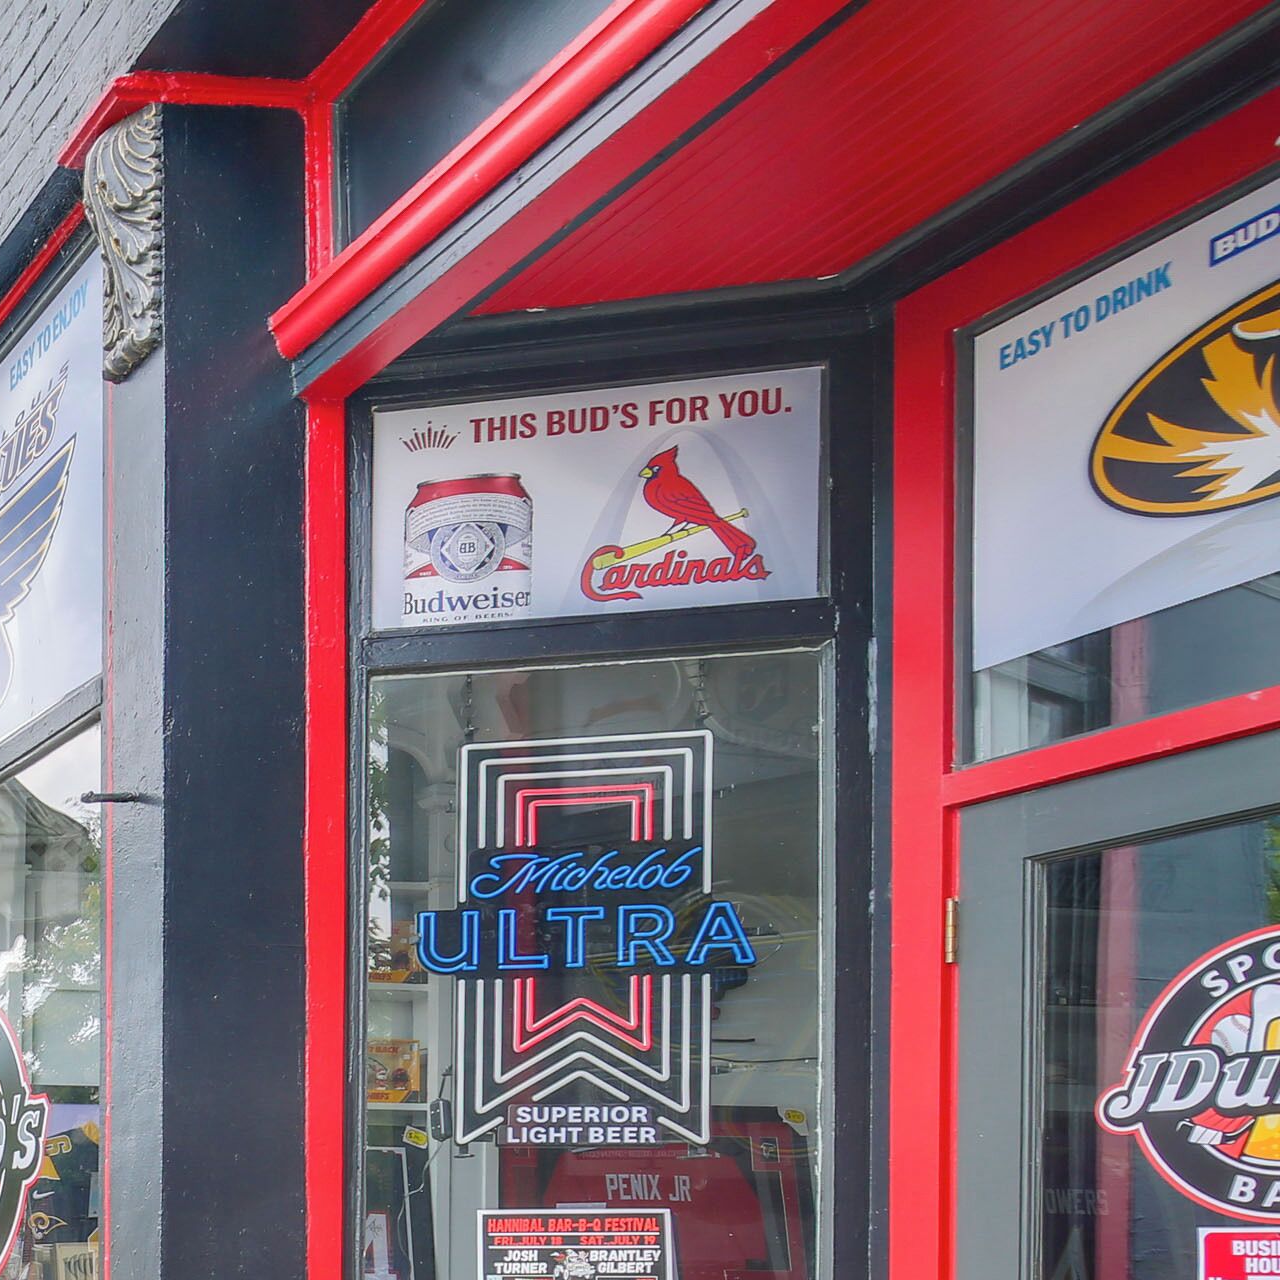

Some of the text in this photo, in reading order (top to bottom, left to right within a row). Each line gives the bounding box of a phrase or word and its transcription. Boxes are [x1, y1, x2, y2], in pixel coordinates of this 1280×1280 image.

[1213, 212, 1280, 261] BUD
[1000, 261, 1173, 370] EASY TO DRINK
[10, 281, 90, 391] EASY TO ENJOY
[470, 387, 793, 445] THIS BUD'S FOR YOU.
[580, 542, 773, 602] Cardinals
[404, 587, 531, 615] Budweiser
[469, 846, 704, 897] Michelob
[416, 901, 757, 974] ULTRA
[516, 1106, 648, 1125] SUPERIOR
[506, 1126, 657, 1144] LIGHT BEER
[605, 1174, 693, 1201] PENIX JR
[1044, 1188, 1109, 1216] OWERS
[488, 1217, 660, 1233] HANNIBAL BAR-B-Q FESTIVAL
[550, 1236, 563, 1246] 18
[644, 1235, 657, 1245] 19
[494, 1262, 548, 1274] TURNER
[503, 1250, 538, 1262] JOSH
[589, 1250, 662, 1262] BRANTLEY
[597, 1262, 654, 1274] GILBERT
